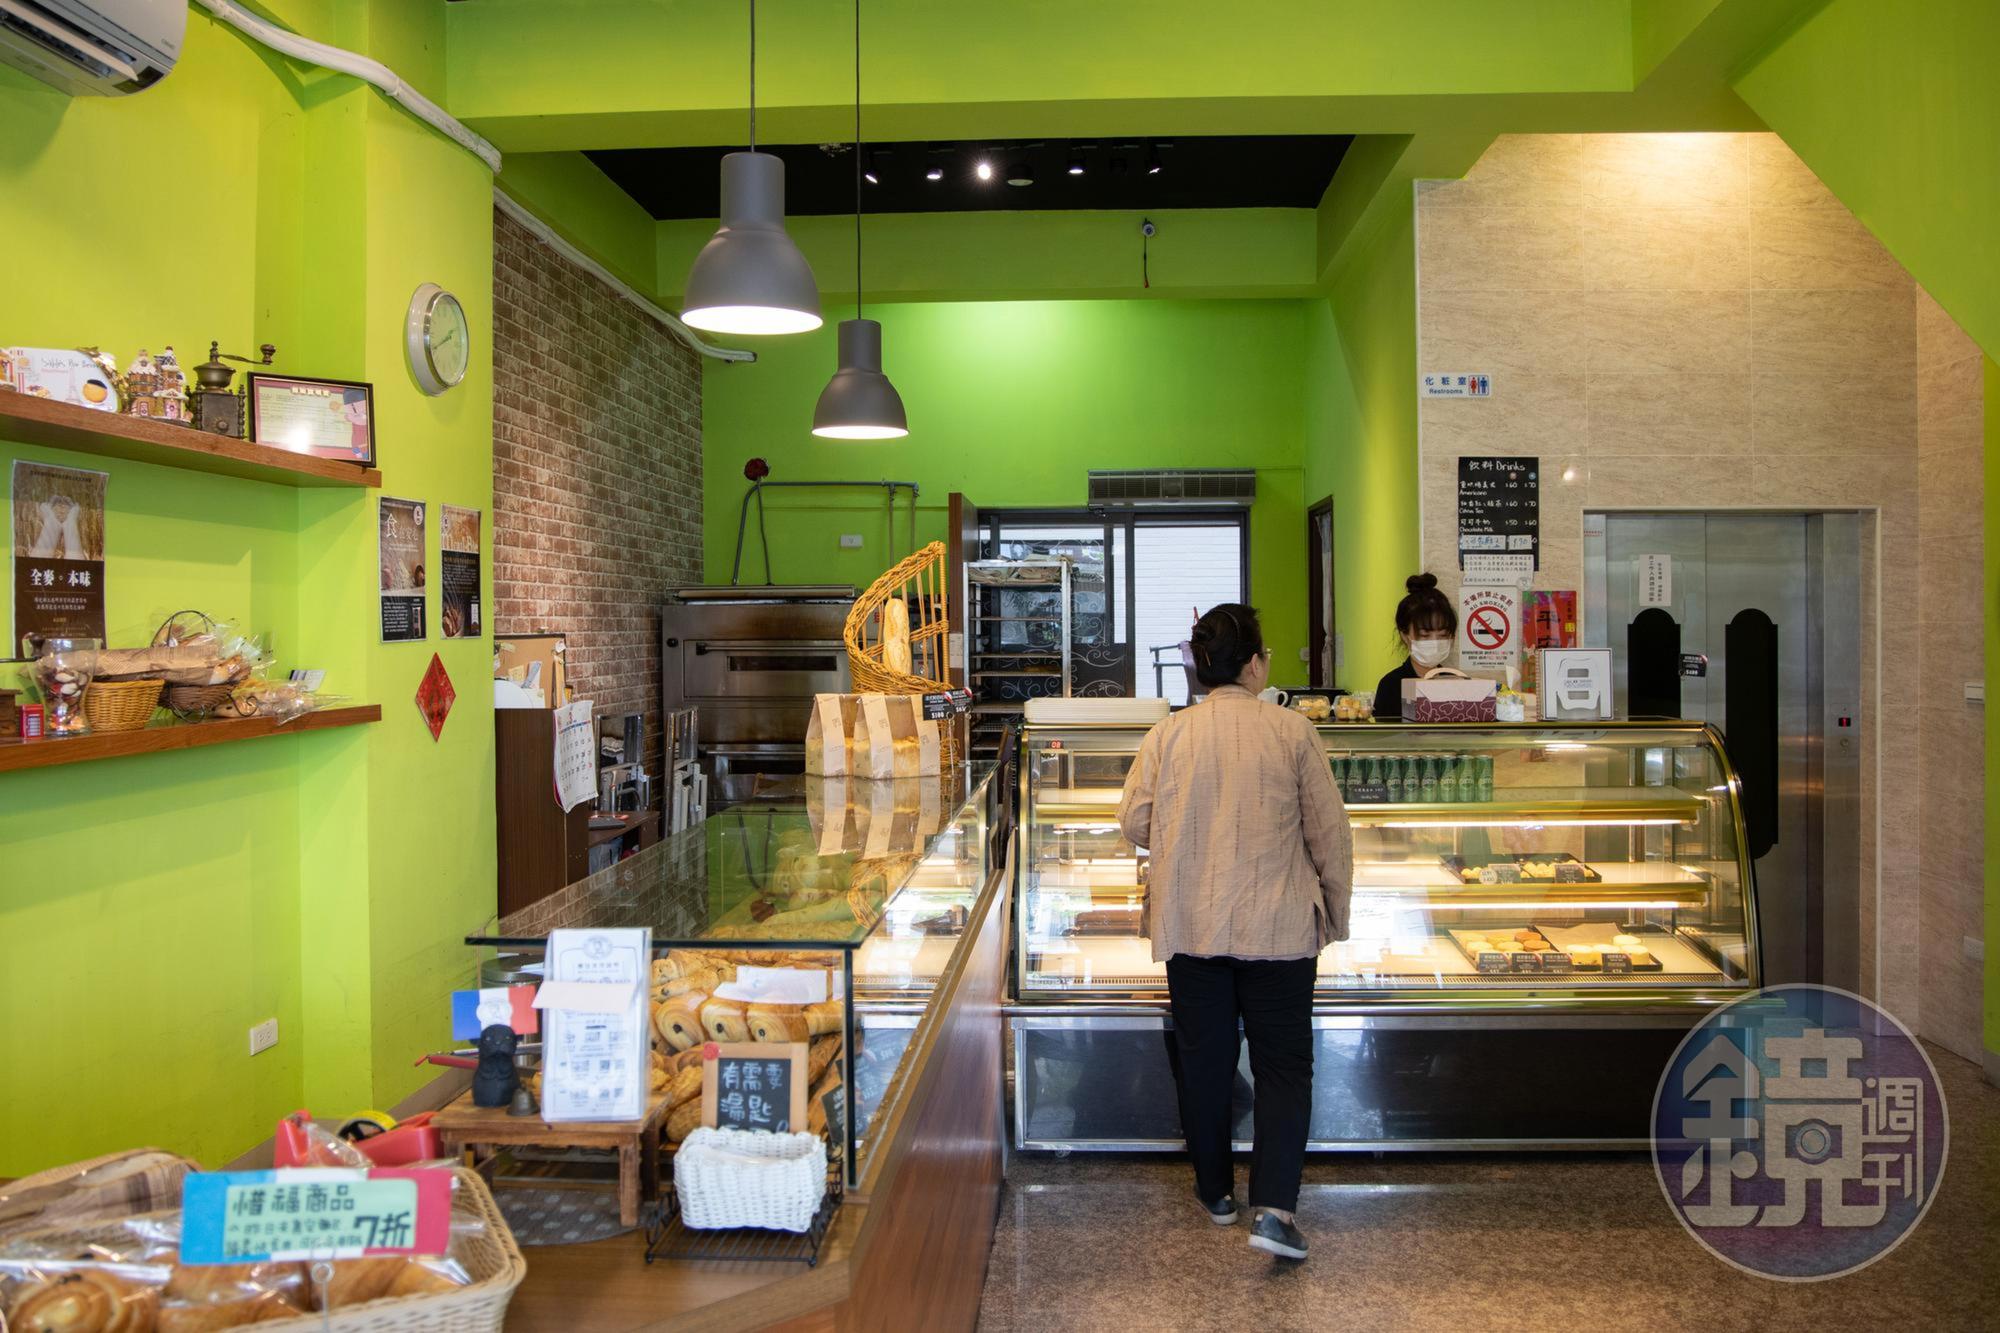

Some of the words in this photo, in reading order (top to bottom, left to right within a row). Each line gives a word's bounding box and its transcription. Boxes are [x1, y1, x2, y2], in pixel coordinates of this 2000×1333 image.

[1469, 461, 1493, 471] 飲料
[1496, 461, 1525, 471] Drinks
[722, 1061, 783, 1091] 有需要
[720, 1092, 772, 1123] 湯匙
[233, 1184, 354, 1216] 惜福商品
[353, 1211, 410, 1249] 7折
